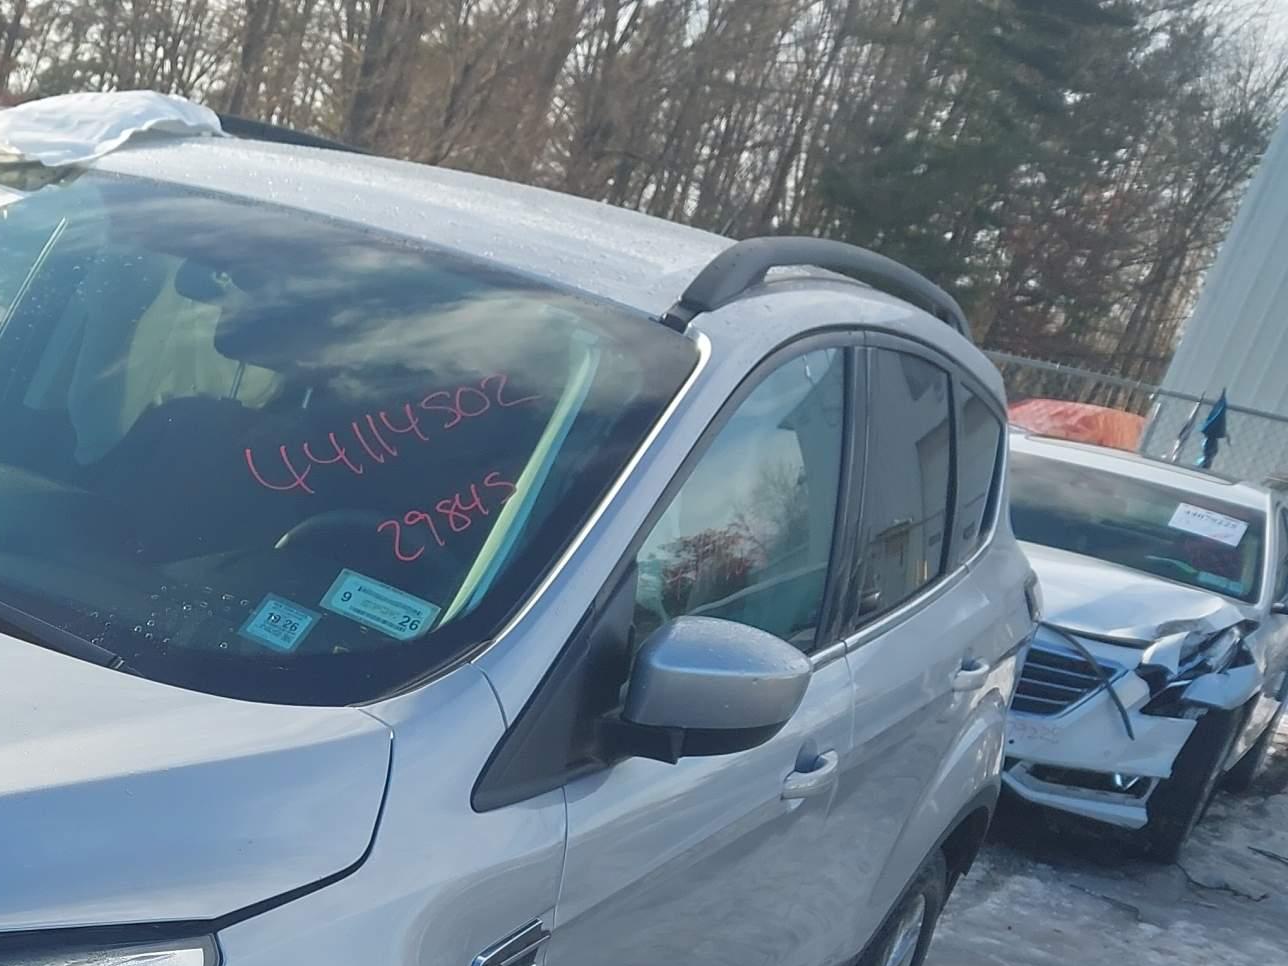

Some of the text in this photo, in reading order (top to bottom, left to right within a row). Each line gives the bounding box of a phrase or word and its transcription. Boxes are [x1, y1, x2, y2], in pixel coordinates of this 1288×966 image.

[244, 374, 542, 494] 44114502
[377, 471, 518, 561] 29845
[340, 590, 353, 603] 9
[282, 618, 300, 632] 26
[398, 615, 422, 632] 26
